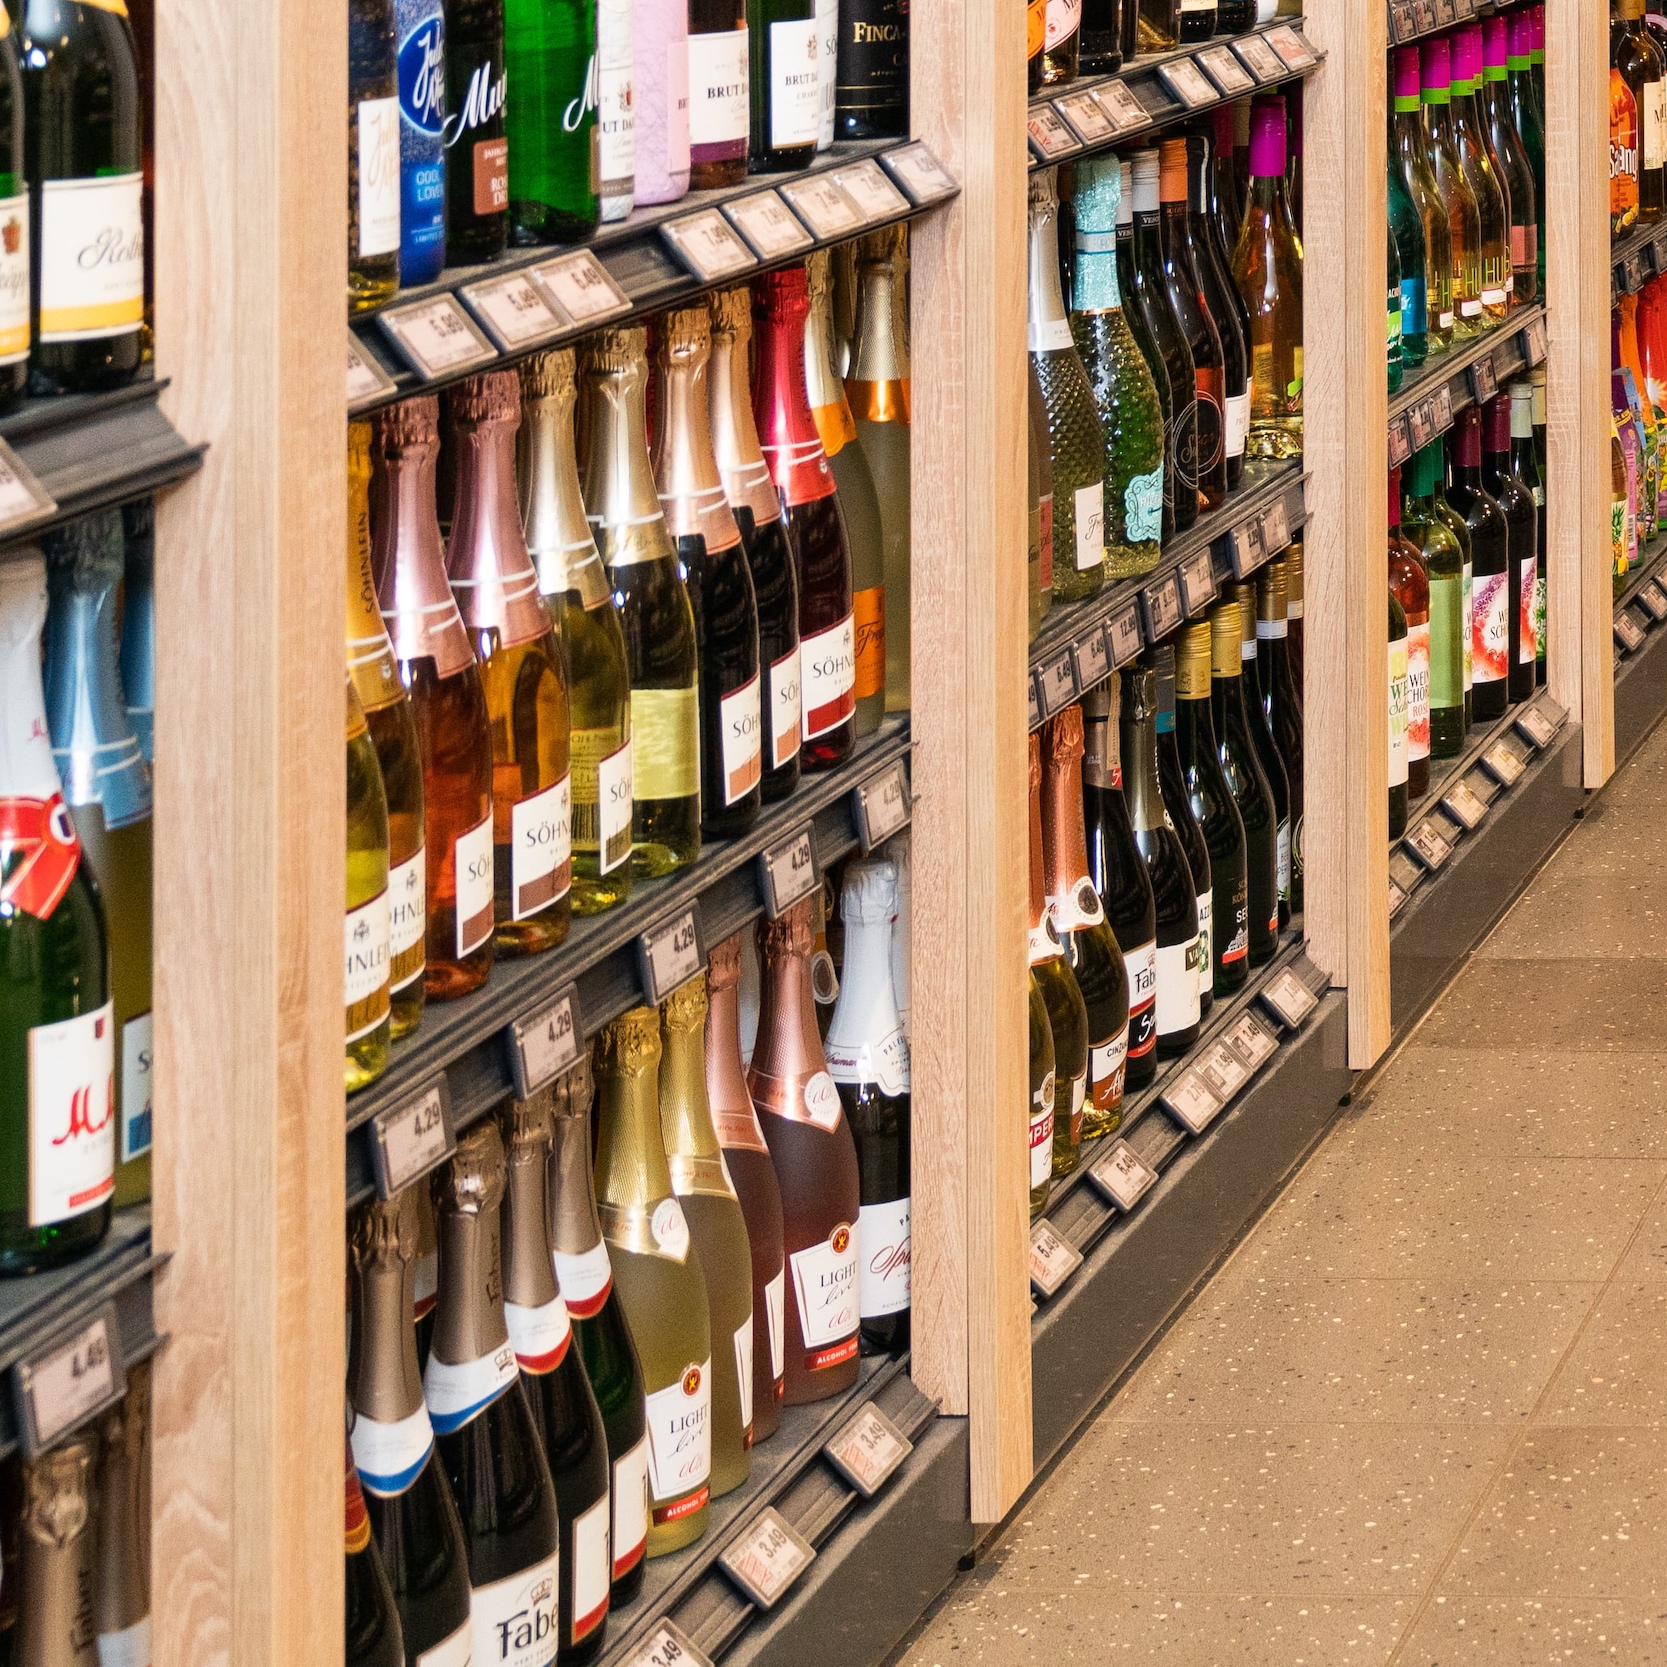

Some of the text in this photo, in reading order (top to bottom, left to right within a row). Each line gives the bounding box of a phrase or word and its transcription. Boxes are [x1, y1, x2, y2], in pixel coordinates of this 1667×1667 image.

[359, 510, 374, 614] SÖHNLEIN
[792, 843, 812, 872] 4.29
[674, 923, 695, 955] 4.29
[547, 1010, 573, 1043] 4.29
[414, 1101, 443, 1134] 4.29
[1115, 1154, 1136, 1177] 6.49
[820, 1260, 858, 1288] LIGHT
[816, 1346, 847, 1366] ALCOHOL
[670, 1403, 708, 1435] LIGHT
[862, 1420, 888, 1450] 3.49
[666, 1498, 699, 1518] ALCOHOL
[758, 1526, 788, 1560] 3.49
[497, 1603, 559, 1659] Fabe
